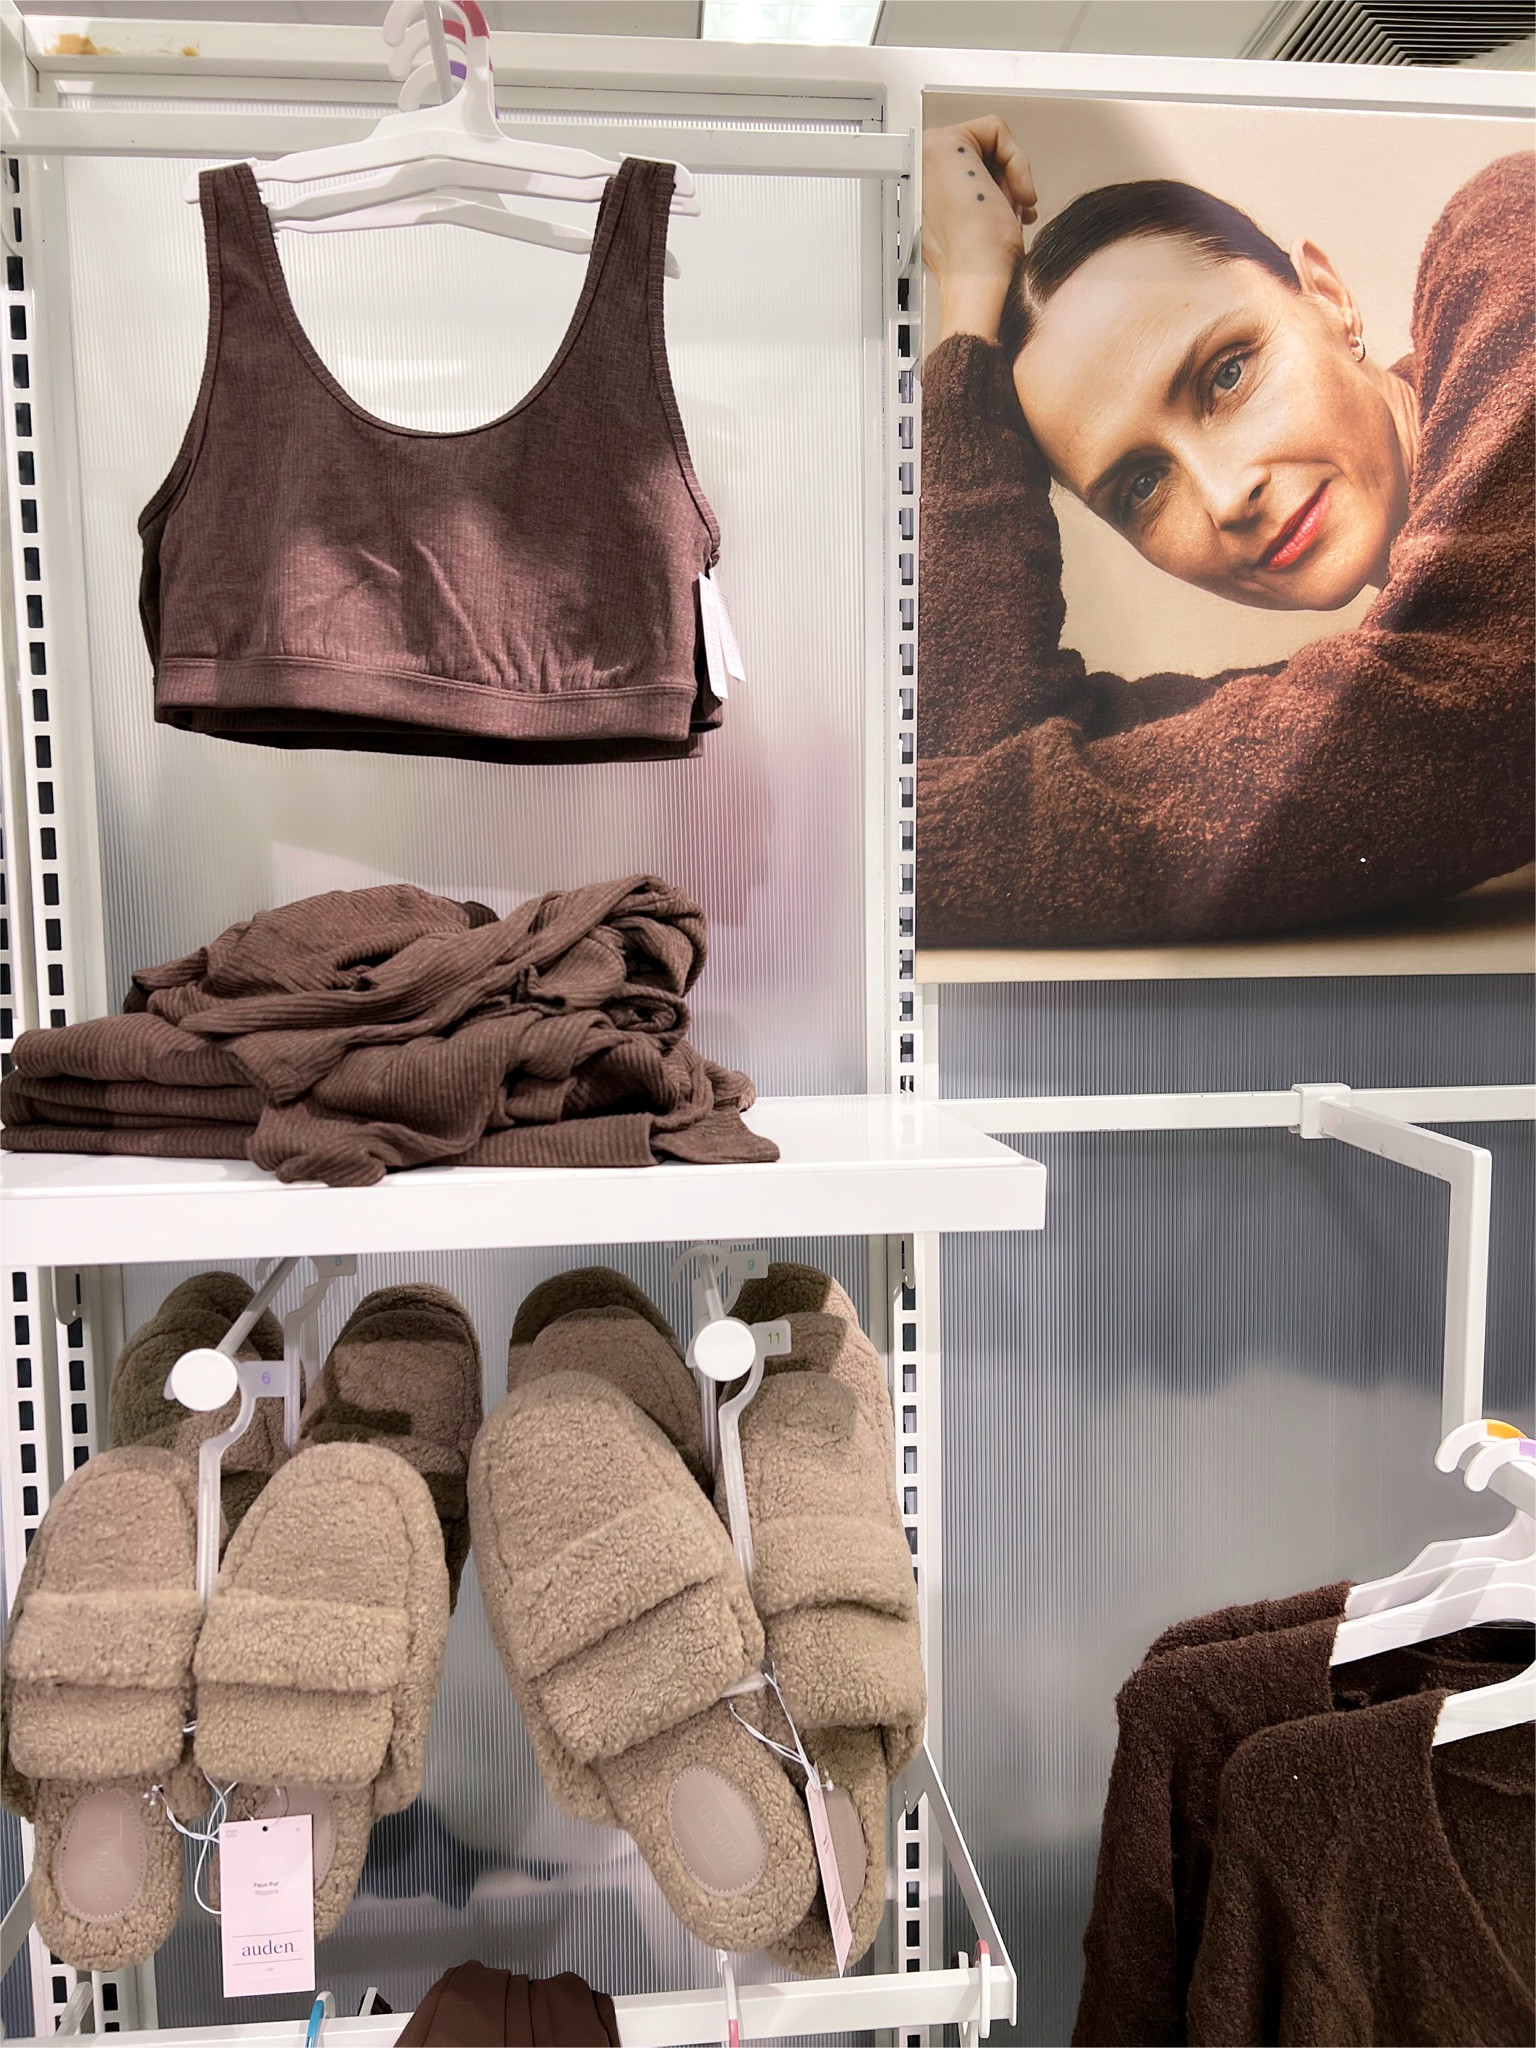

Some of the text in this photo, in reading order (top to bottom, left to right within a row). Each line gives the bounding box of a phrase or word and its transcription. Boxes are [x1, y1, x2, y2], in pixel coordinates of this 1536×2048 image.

[747, 1259, 754, 1270] 9
[767, 1331, 781, 1345] 11
[261, 1371, 271, 1385] 6
[241, 1939, 294, 1957] auden
